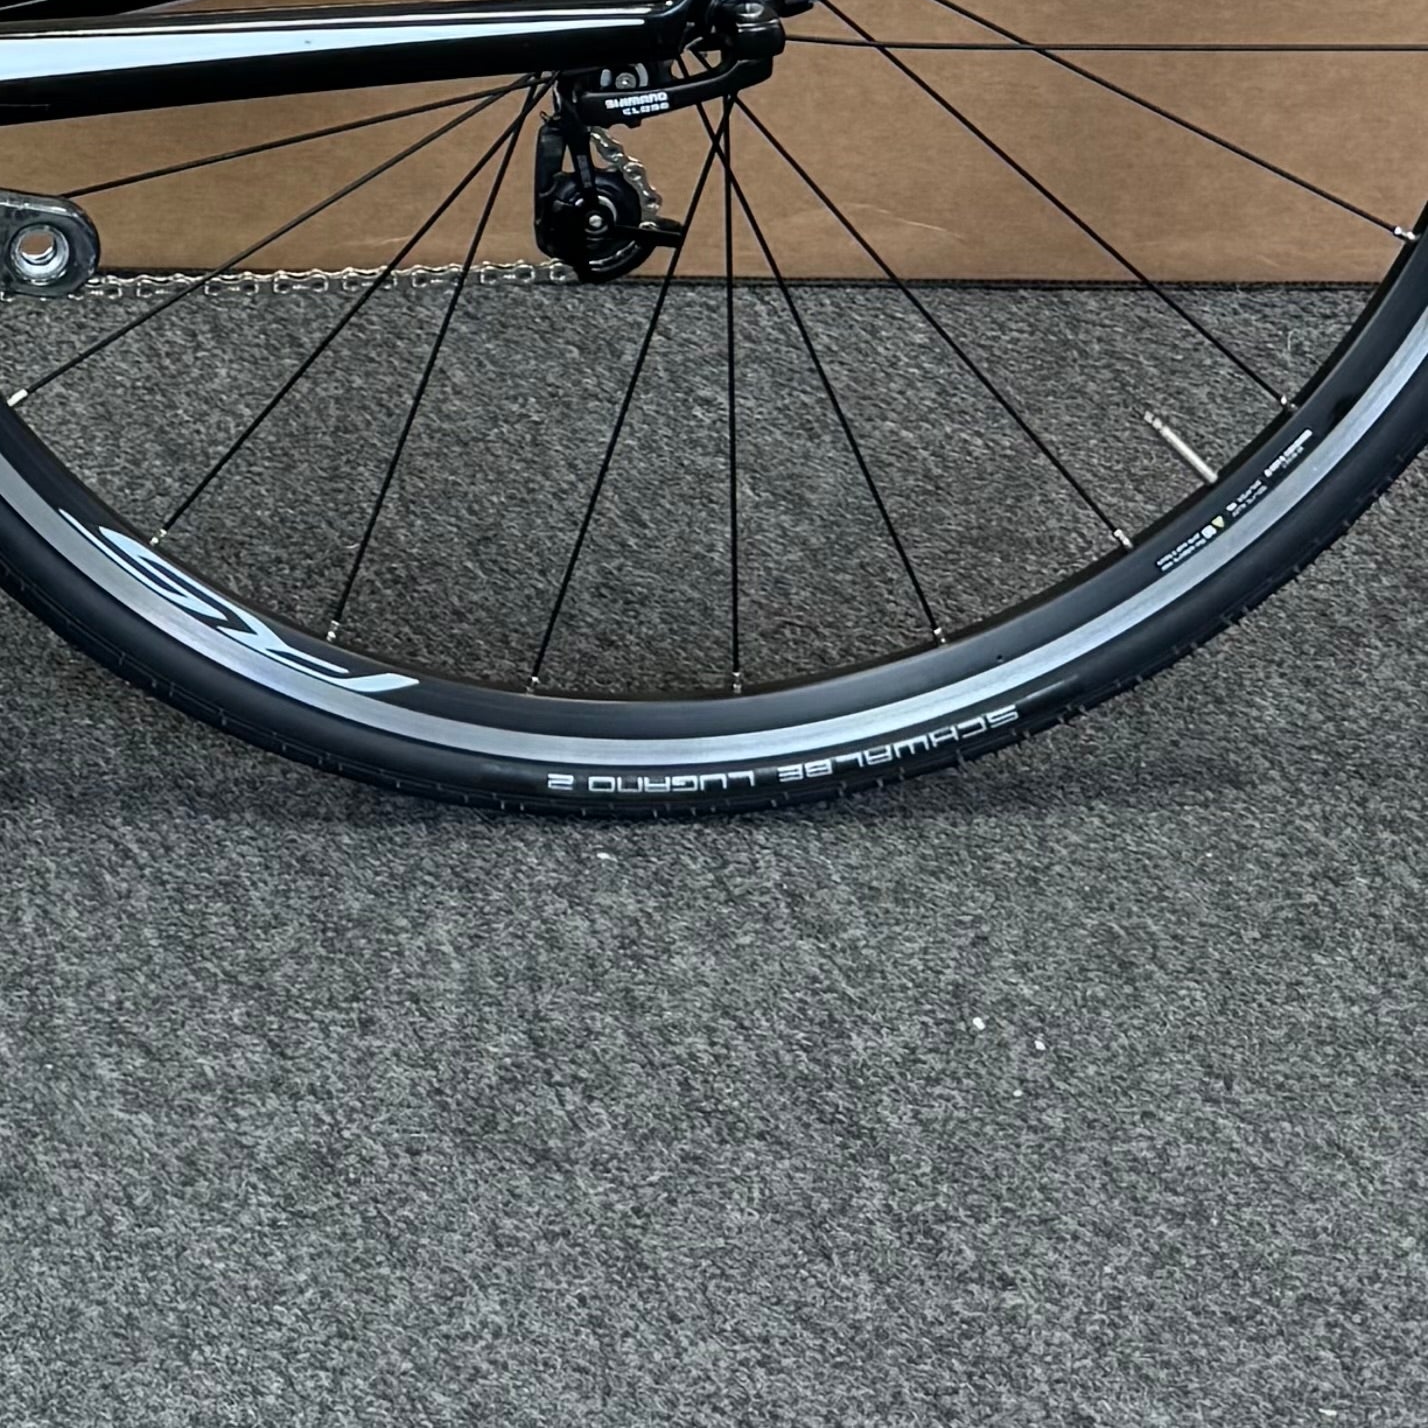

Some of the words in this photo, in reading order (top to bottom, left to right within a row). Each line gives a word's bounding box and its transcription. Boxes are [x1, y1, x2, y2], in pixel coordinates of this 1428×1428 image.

[777, 705, 1020, 785] SCHWALBE
[546, 772, 575, 792] 2
[587, 770, 757, 794] LUGANO
